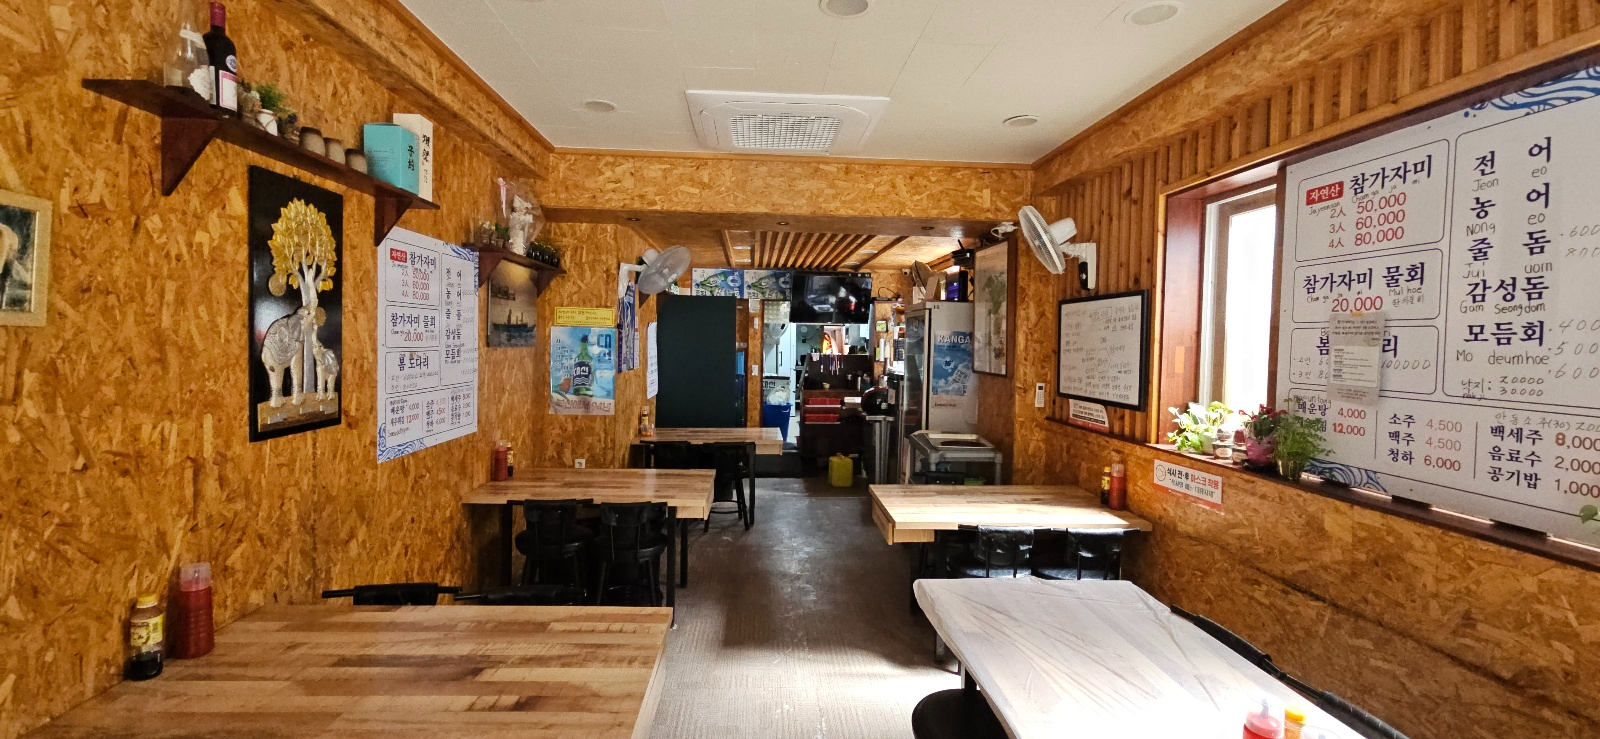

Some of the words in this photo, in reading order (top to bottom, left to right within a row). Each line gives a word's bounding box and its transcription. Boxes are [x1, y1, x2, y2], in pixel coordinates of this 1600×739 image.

[1309, 185, 1341, 202] 자연산
[1349, 155, 1432, 196] 참가자미
[1471, 178, 1499, 193] Jeon
[1531, 166, 1548, 178] eo
[1330, 207, 1346, 219] 2人
[1356, 192, 1407, 215] 50,000
[1329, 222, 1346, 235] 3人
[1355, 209, 1406, 232] 60,000
[1527, 213, 1546, 226] eo
[1328, 238, 1345, 249] 4人
[1354, 226, 1405, 248] 80,000
[409, 251, 437, 270] 참가자미
[1302, 267, 1373, 295] 참가자미
[1382, 262, 1425, 289] 물회
[1465, 275, 1551, 304] 감성돔
[1331, 296, 1383, 313] 20,000
[1459, 300, 1484, 315] Gam
[390, 312, 421, 329] 참가자미
[403, 330, 424, 342] 20,000
[1463, 320, 1545, 347] 모듬회
[1456, 349, 1474, 363] Mo
[1298, 402, 1327, 417] 매운탕
[1337, 407, 1366, 420] 4,000
[1332, 422, 1366, 437] 12,000
[1388, 413, 1416, 429] 소주
[1426, 418, 1463, 433] 4,500
[1388, 430, 1416, 447] 맥주
[1425, 437, 1462, 452] 4,500
[1490, 425, 1544, 447] 백세주
[1555, 432, 1600, 452] 8,000
[1387, 448, 1415, 466] 청하
[1424, 454, 1461, 472] 6,000
[1487, 445, 1543, 468] 음료수
[1554, 455, 1600, 475] 2,000
[1166, 467, 1177, 478] 식사
[1190, 473, 1207, 487] 마스크
[1487, 465, 1542, 490] 공기밥
[1554, 478, 1600, 499] 1,000
